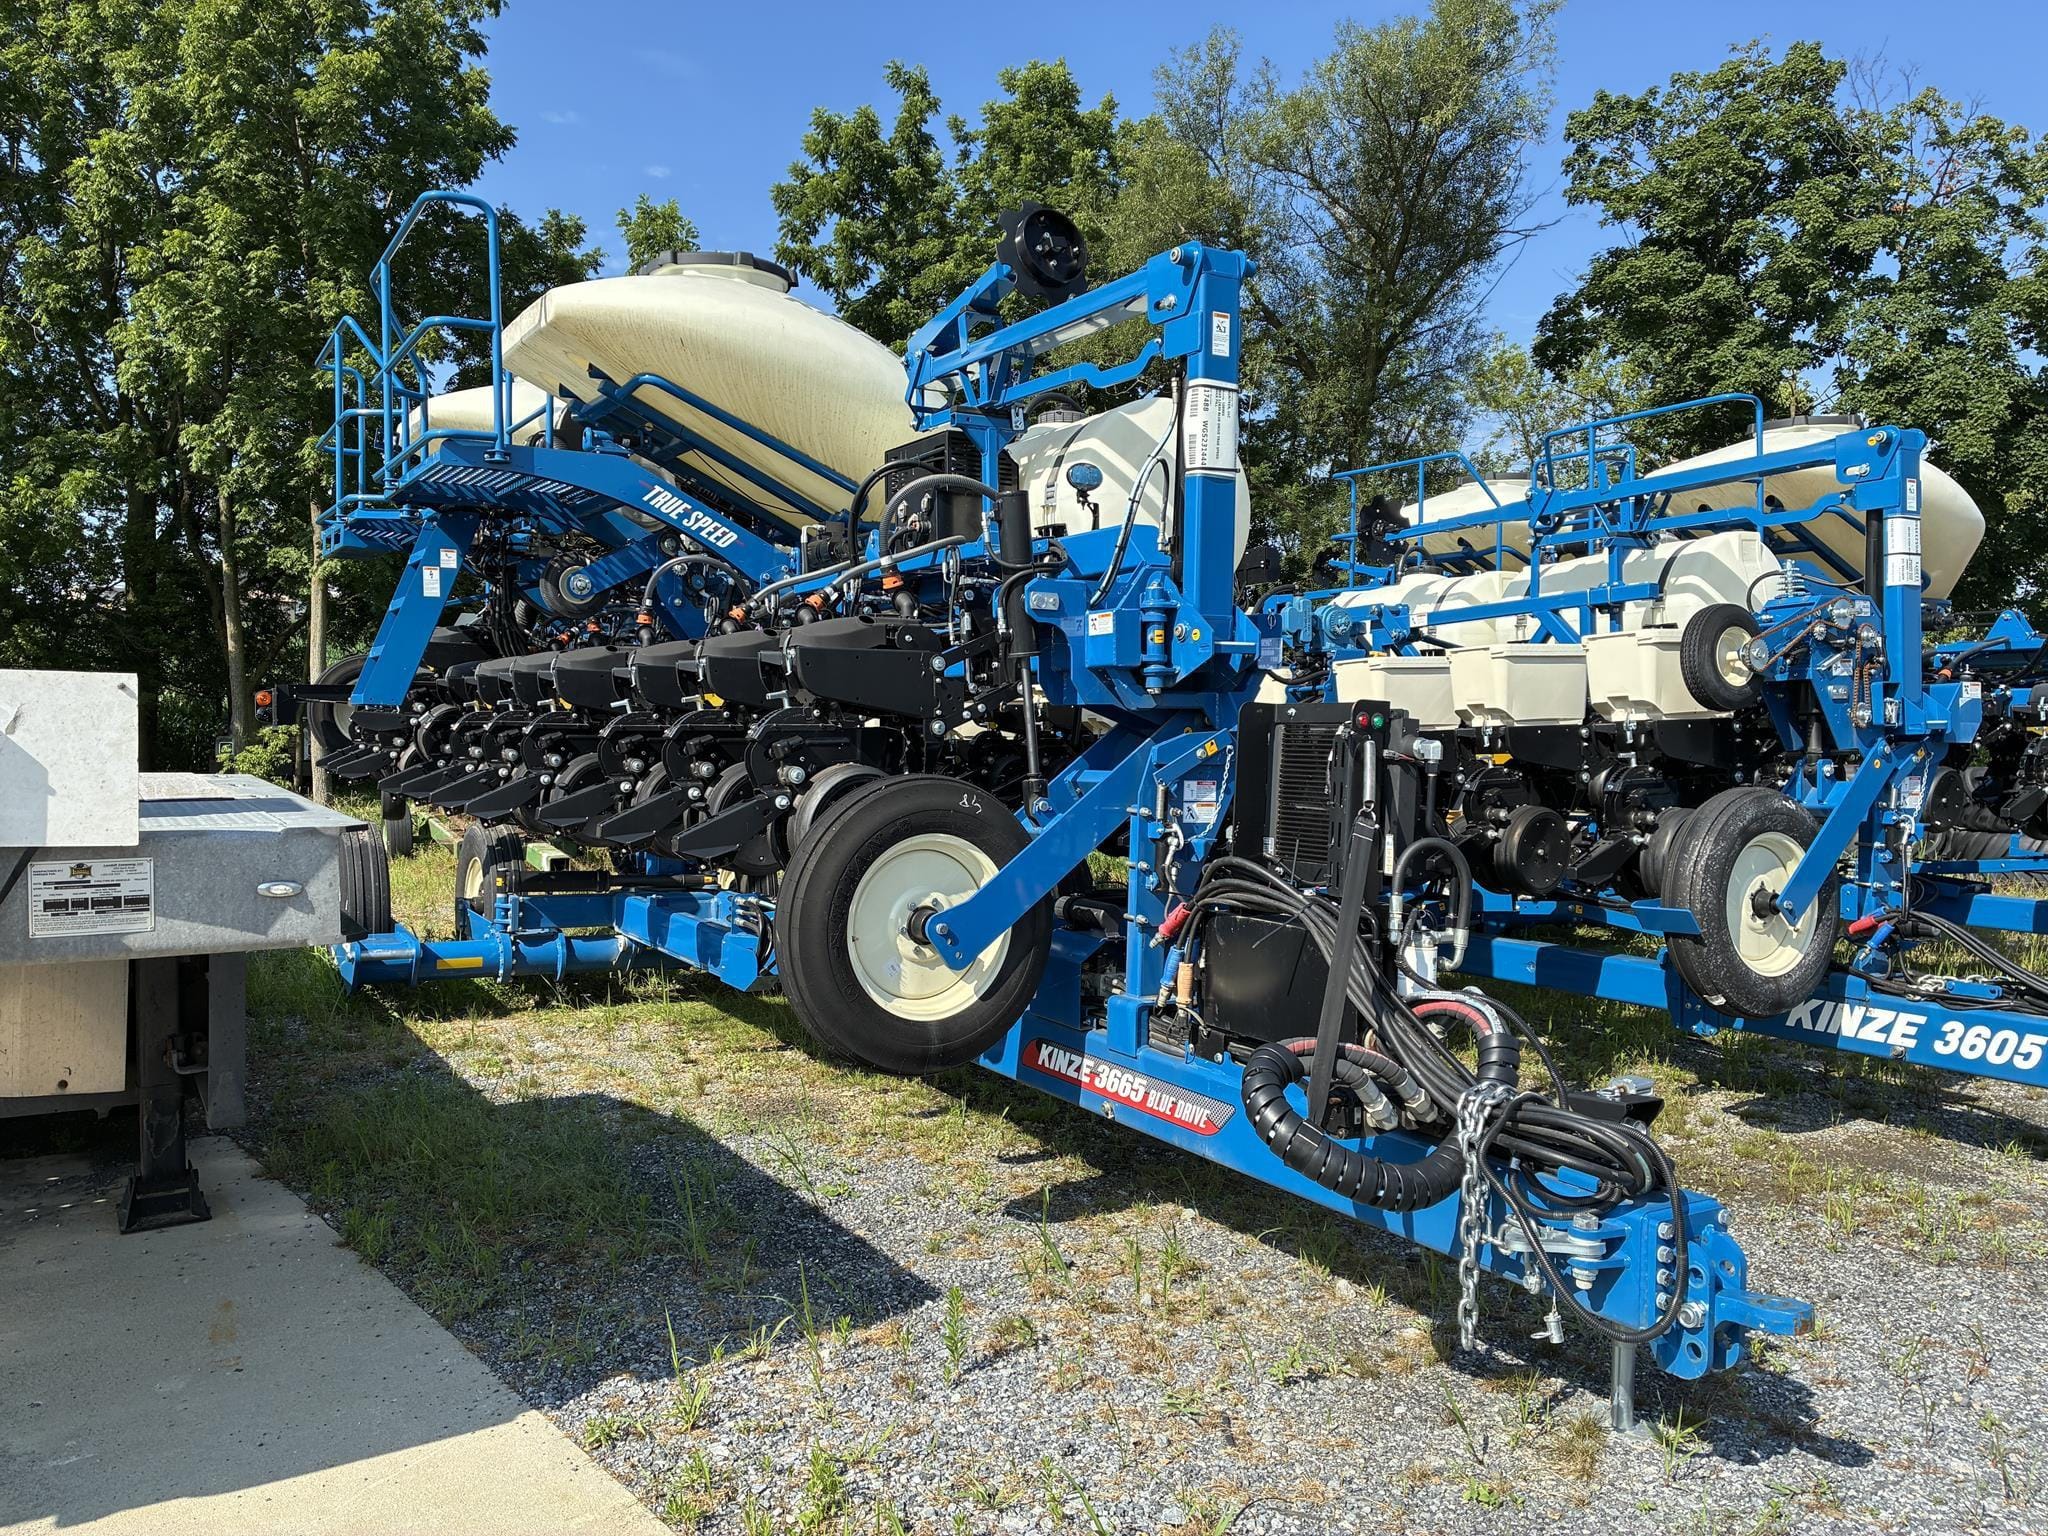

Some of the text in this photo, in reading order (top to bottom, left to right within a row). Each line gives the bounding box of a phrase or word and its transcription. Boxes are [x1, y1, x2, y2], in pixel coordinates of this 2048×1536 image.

[642, 485, 738, 548] TRUE SPEED
[1785, 999, 2048, 1070] KINZE 3605
[1037, 1043, 1212, 1128] KINZE 3665 BLUE DRIVE
